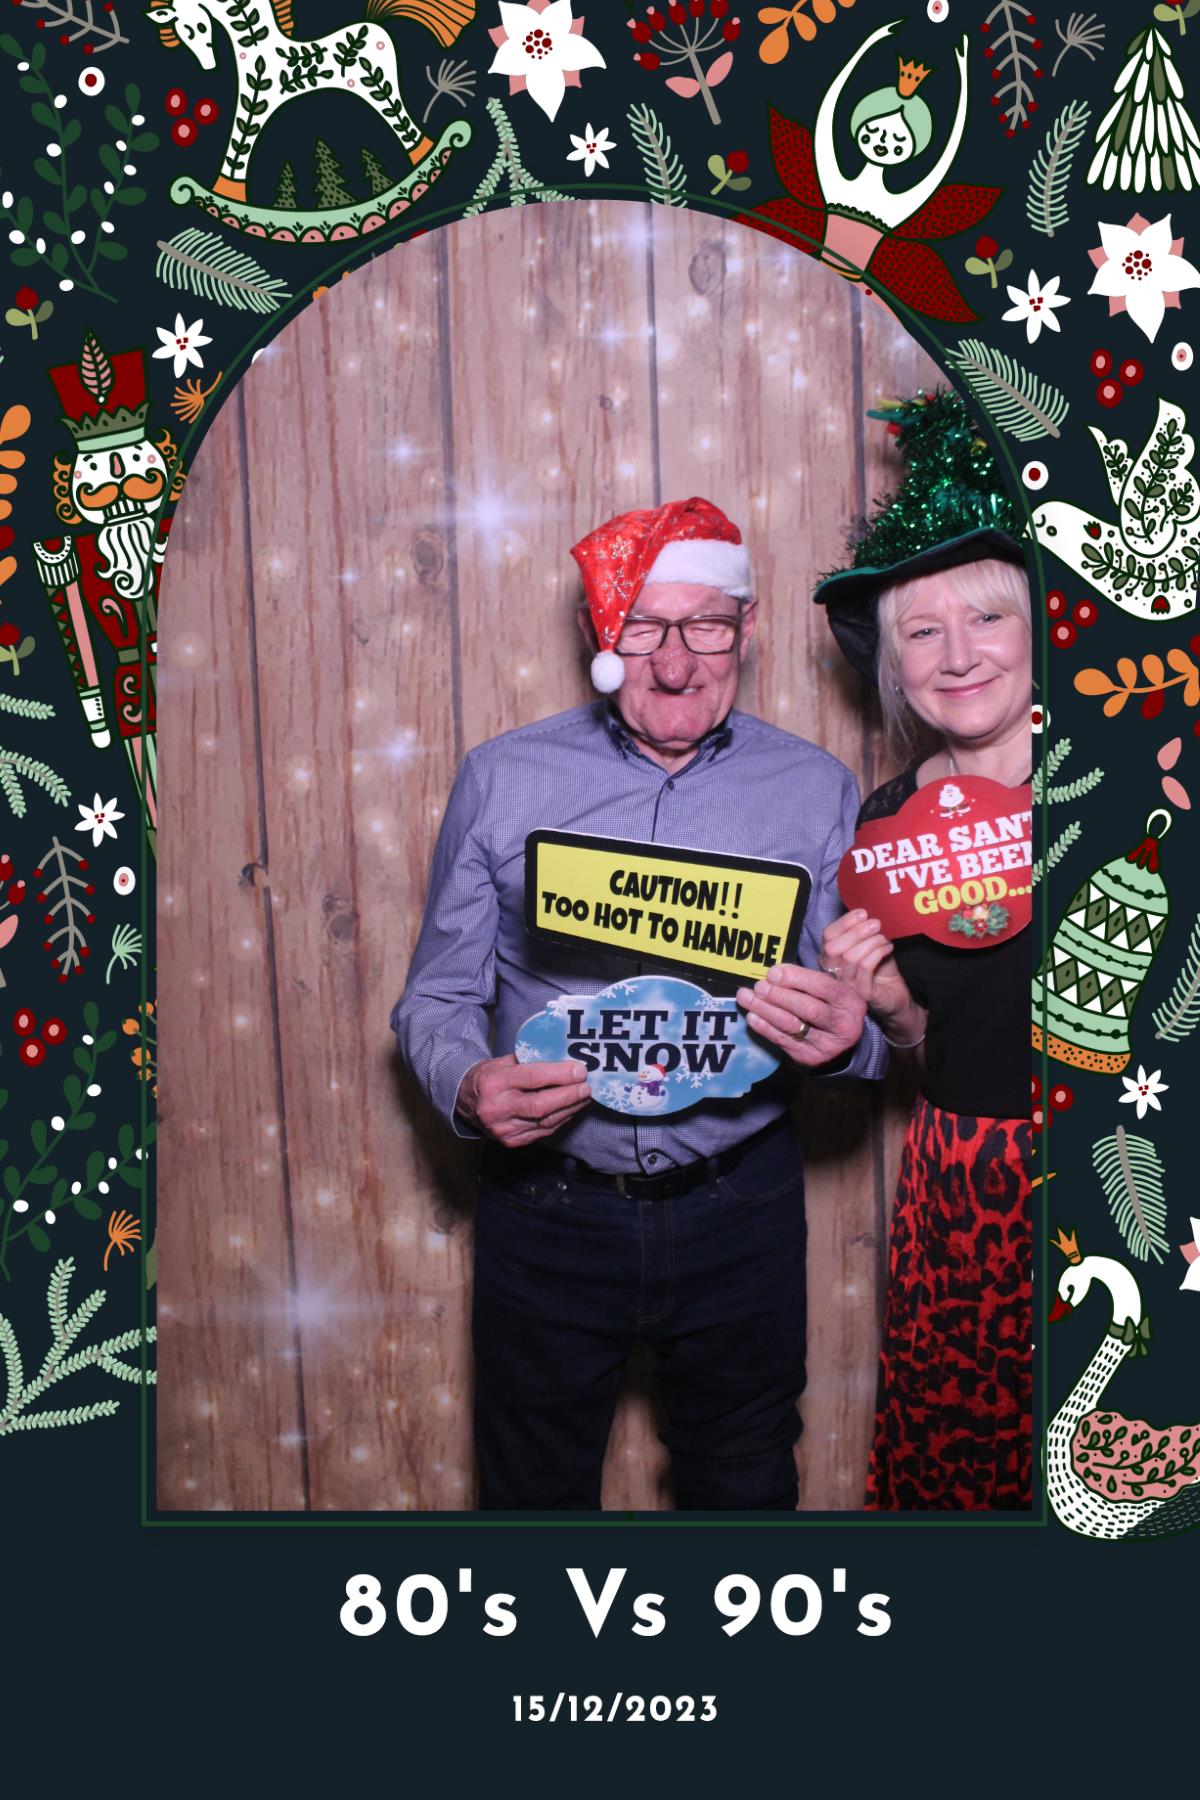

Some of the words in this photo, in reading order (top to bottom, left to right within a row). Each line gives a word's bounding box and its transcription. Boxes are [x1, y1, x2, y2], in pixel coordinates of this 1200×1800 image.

[851, 833, 944, 874] DEAR
[609, 869, 743, 919] CAUTION!!
[885, 859, 953, 894] I'VE
[542, 891, 589, 922] TOO
[593, 902, 644, 934] HOT
[647, 912, 679, 943] TO
[682, 920, 781, 968] HANDLE
[566, 1009, 669, 1041] LET
[682, 1010, 738, 1041] IT
[566, 1042, 736, 1073] SNOW
